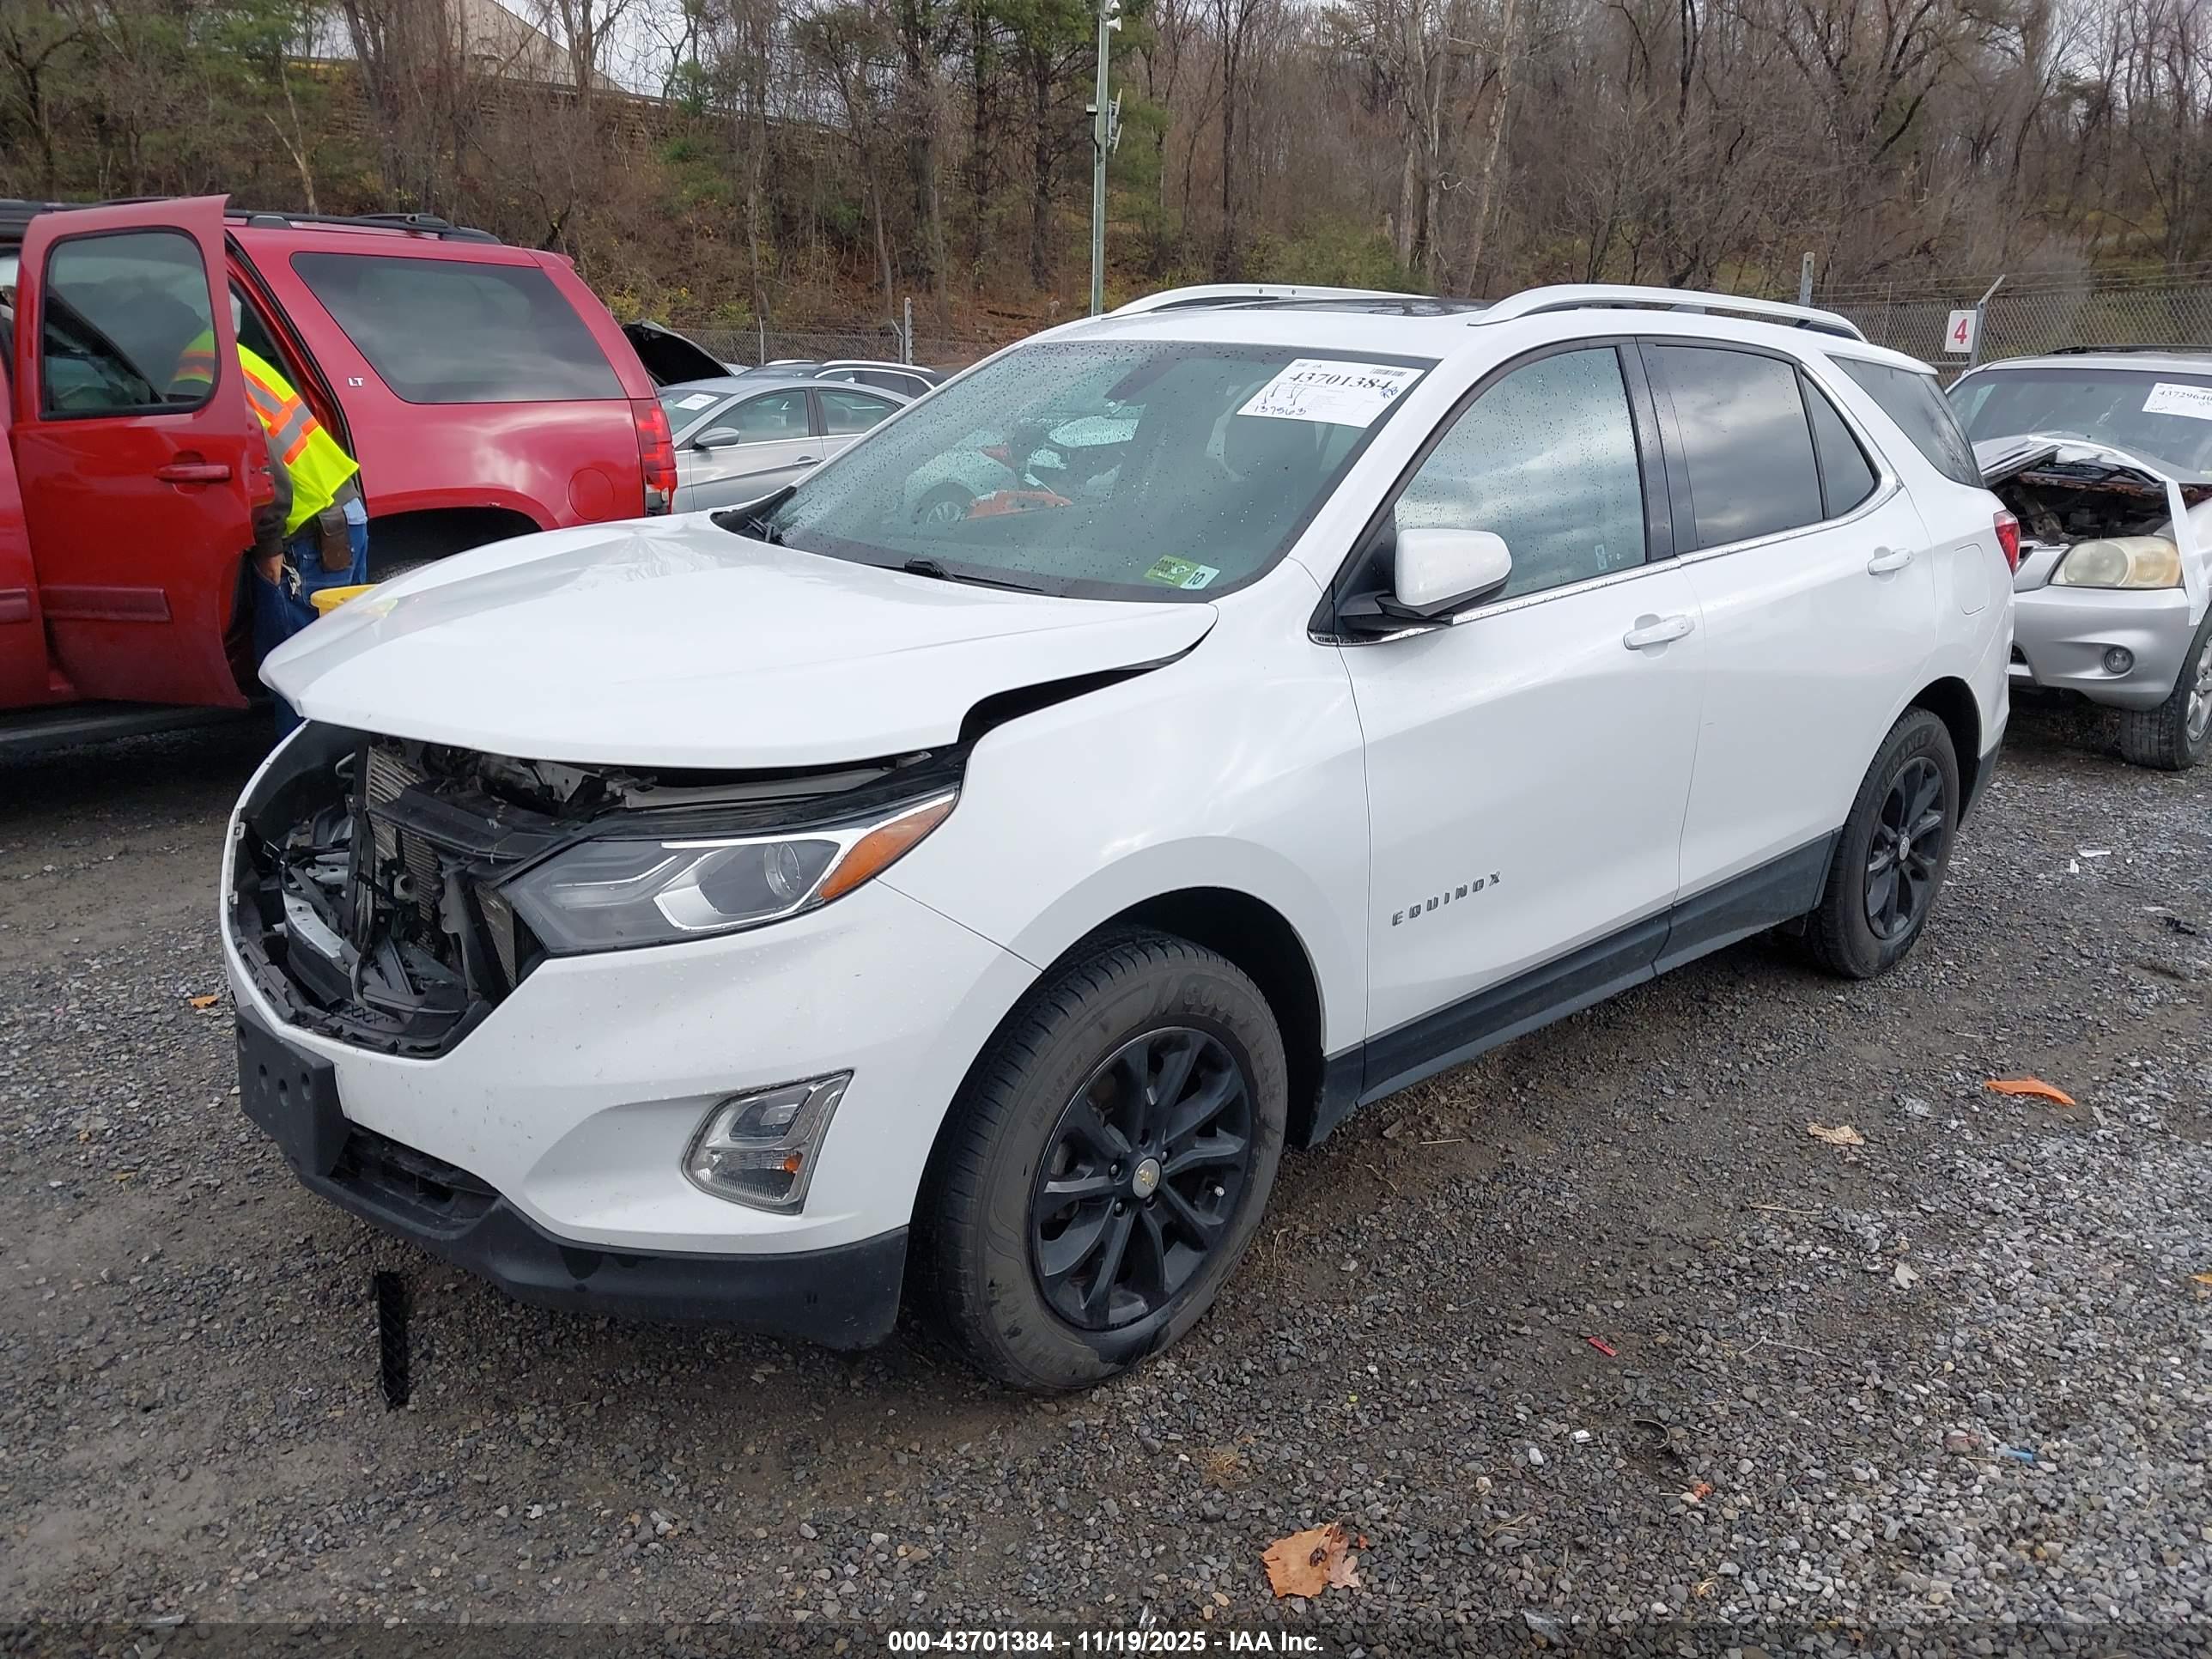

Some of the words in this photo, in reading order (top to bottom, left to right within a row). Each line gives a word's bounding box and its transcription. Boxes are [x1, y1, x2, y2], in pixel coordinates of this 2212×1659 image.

[1954, 318, 1968, 344] 4
[348, 377, 364, 386] LT
[1289, 372, 1394, 390] 43701384
[1188, 571, 1206, 585] 10
[1392, 871, 1500, 927] EQUINOX
